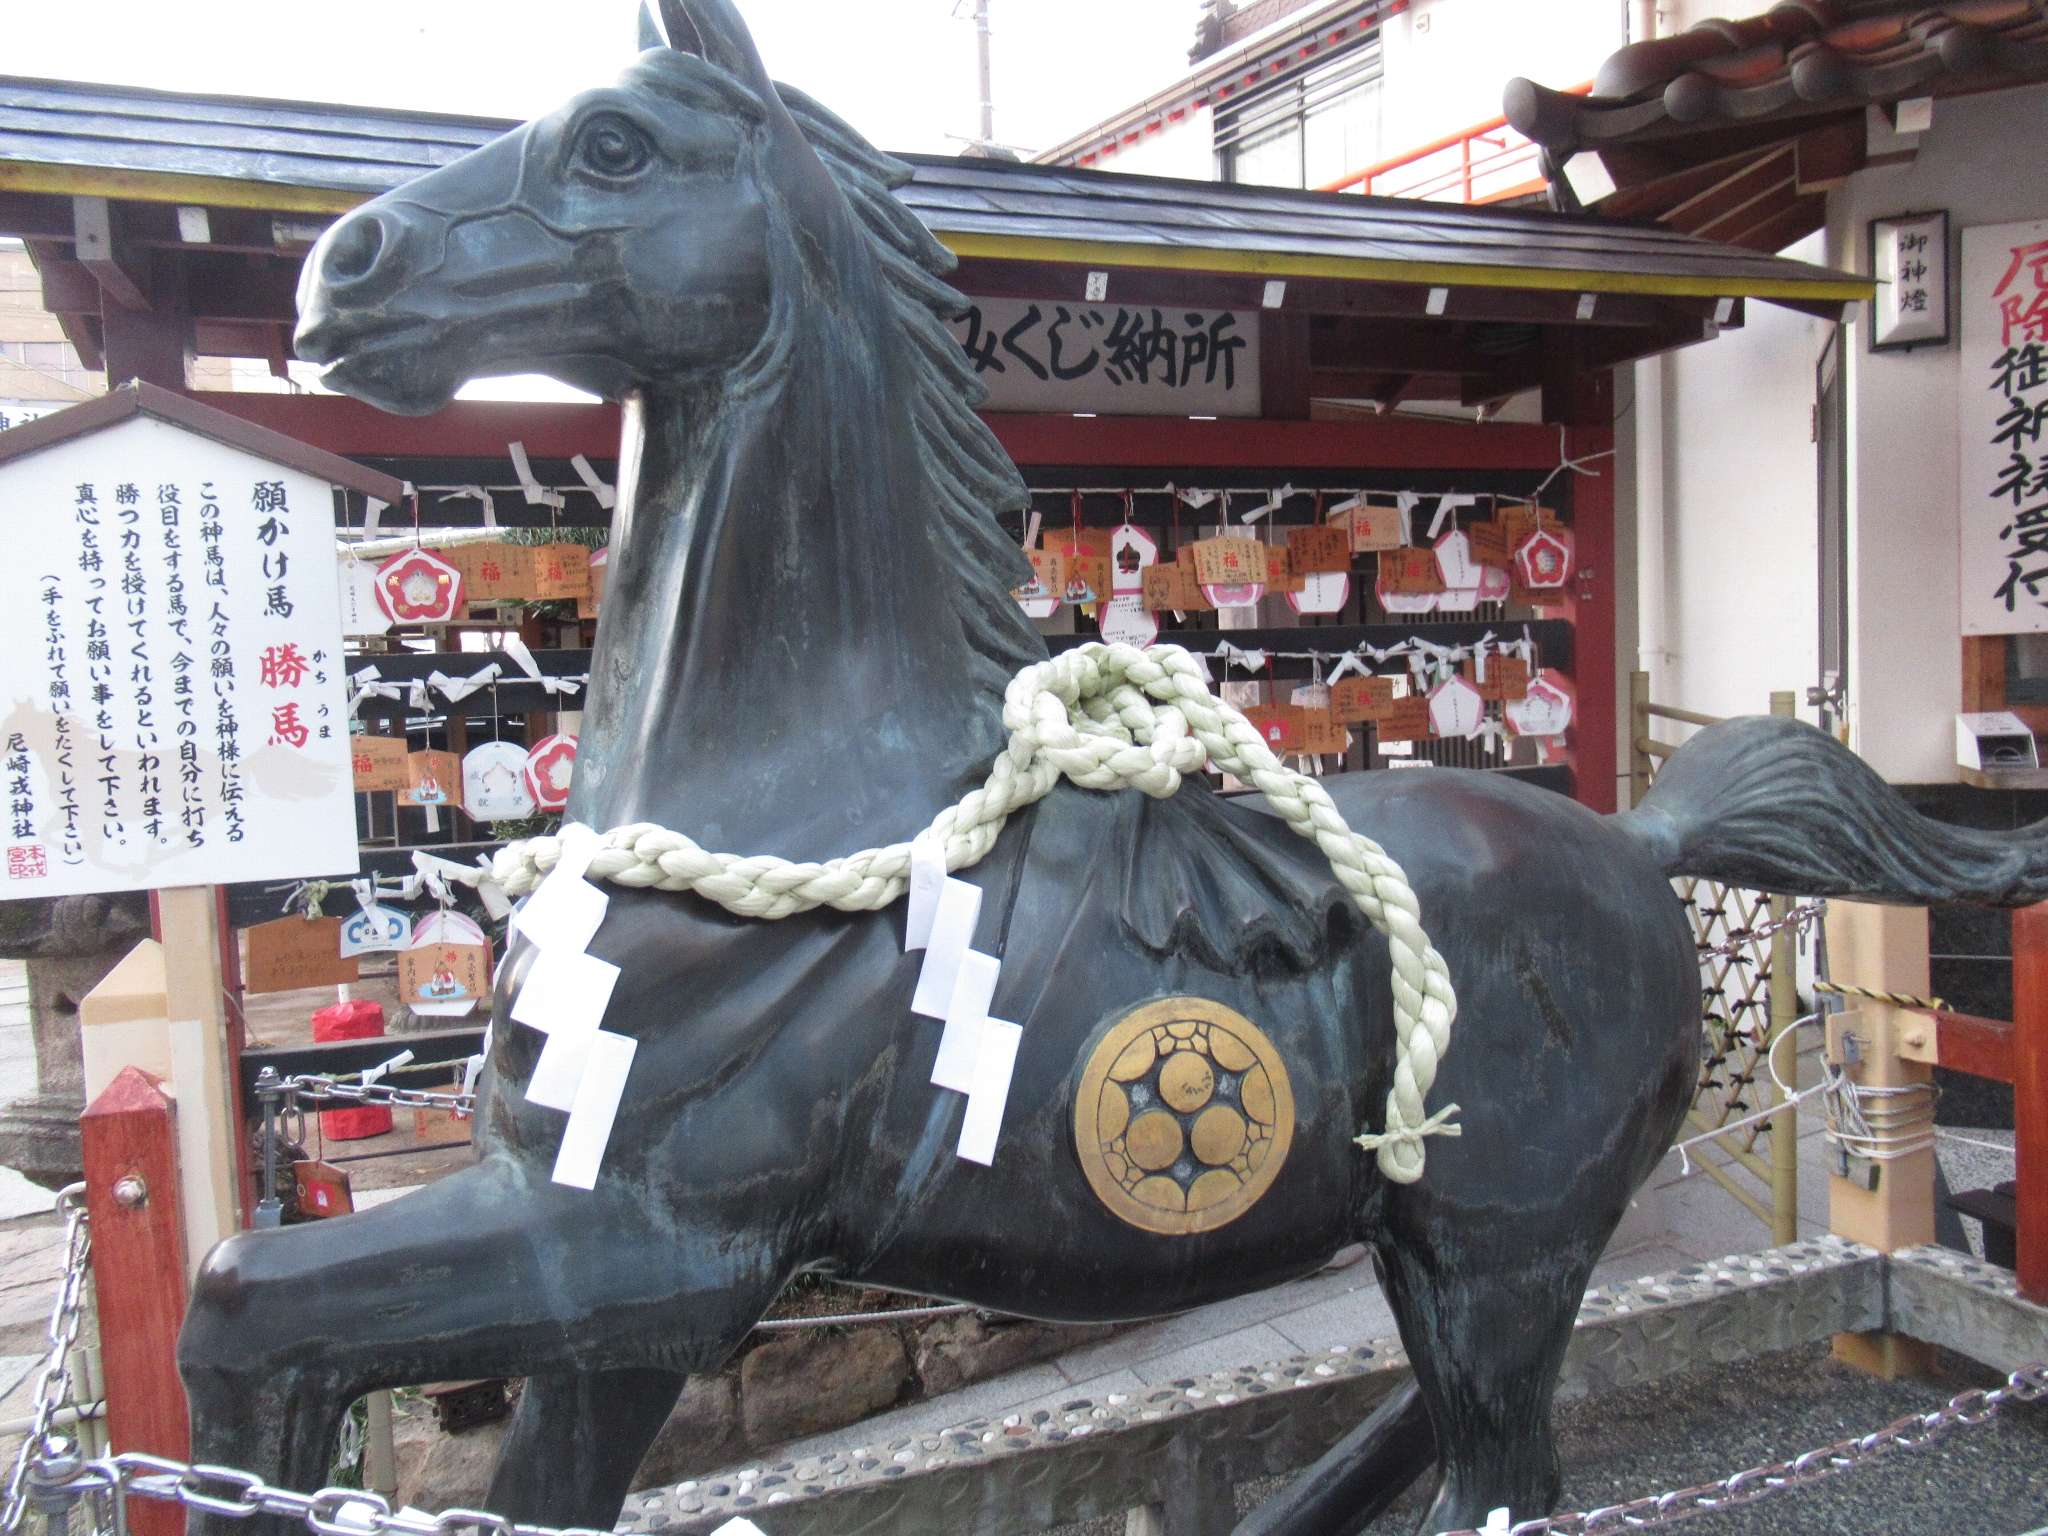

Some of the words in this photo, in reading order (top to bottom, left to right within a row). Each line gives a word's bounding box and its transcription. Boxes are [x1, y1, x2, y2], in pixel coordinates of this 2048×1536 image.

[75, 483, 126, 846] 真心を持ってお願い事をして下さい。
[116, 483, 168, 844] 勝つ力を授けてくれるといわれます。
[157, 484, 206, 848] 役目をする馬で、今までの自分に打ち
[200, 482, 245, 842] この神馬は、人々の願いを神様に伝える
[252, 481, 294, 618] 願かけ馬
[260, 643, 310, 748] 勝馬
[6, 733, 36, 839] 尼崎戎神社
